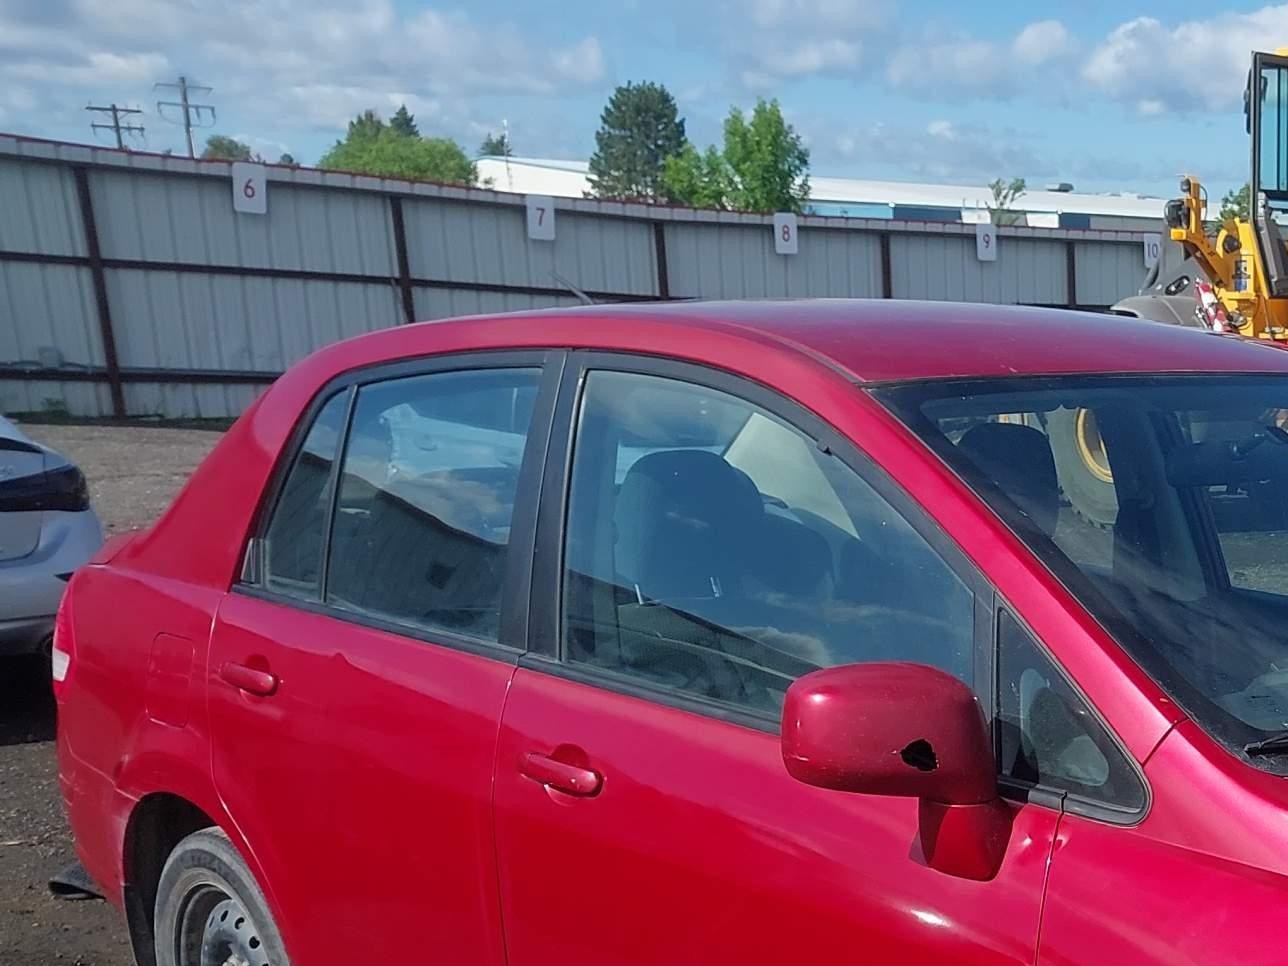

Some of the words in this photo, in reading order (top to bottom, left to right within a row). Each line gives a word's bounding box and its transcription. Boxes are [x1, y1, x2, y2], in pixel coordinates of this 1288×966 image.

[244, 178, 255, 199] 6
[535, 206, 546, 226] 7
[782, 224, 791, 242] 8
[983, 233, 991, 248] 9
[1147, 243, 1159, 258] 10
